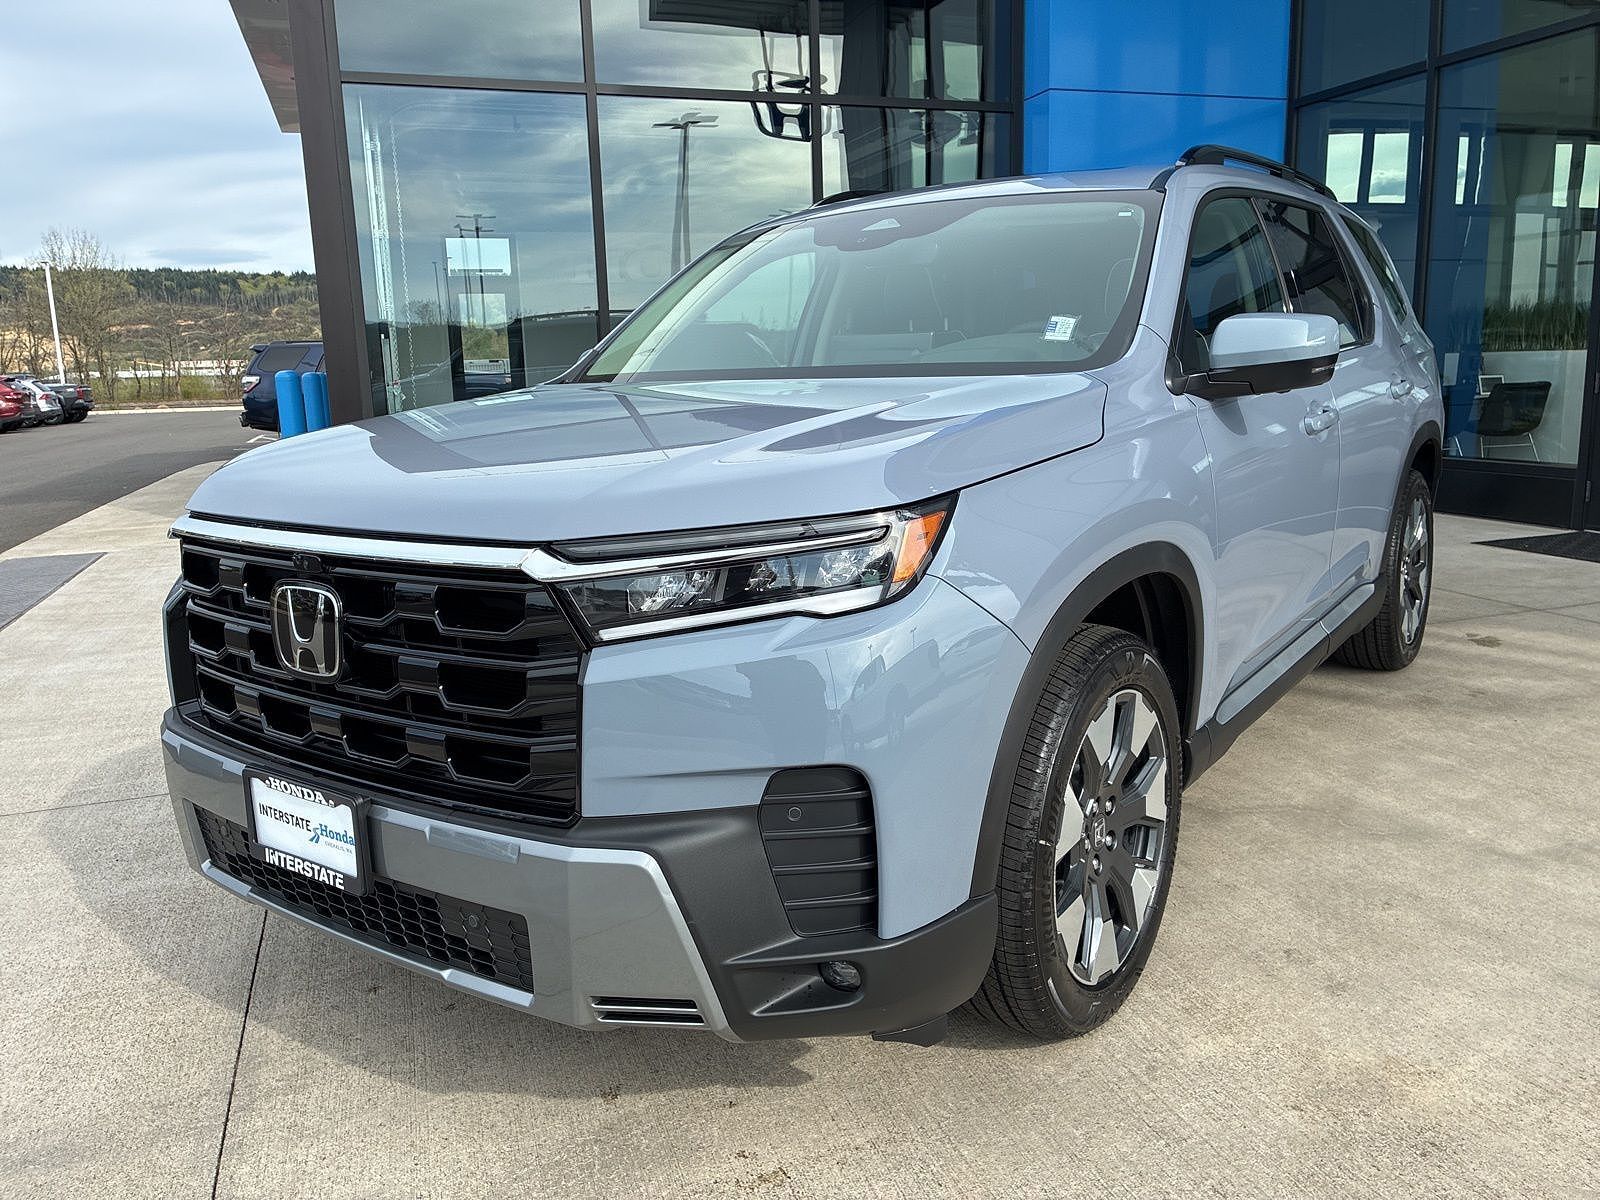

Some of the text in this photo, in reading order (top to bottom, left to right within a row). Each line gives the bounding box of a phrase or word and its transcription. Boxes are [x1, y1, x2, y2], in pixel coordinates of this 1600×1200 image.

[282, 586, 331, 676] H
[268, 777, 328, 807] HONDA
[259, 802, 355, 846] INTERSTATE Honda
[264, 848, 345, 890] INTERSTATE
